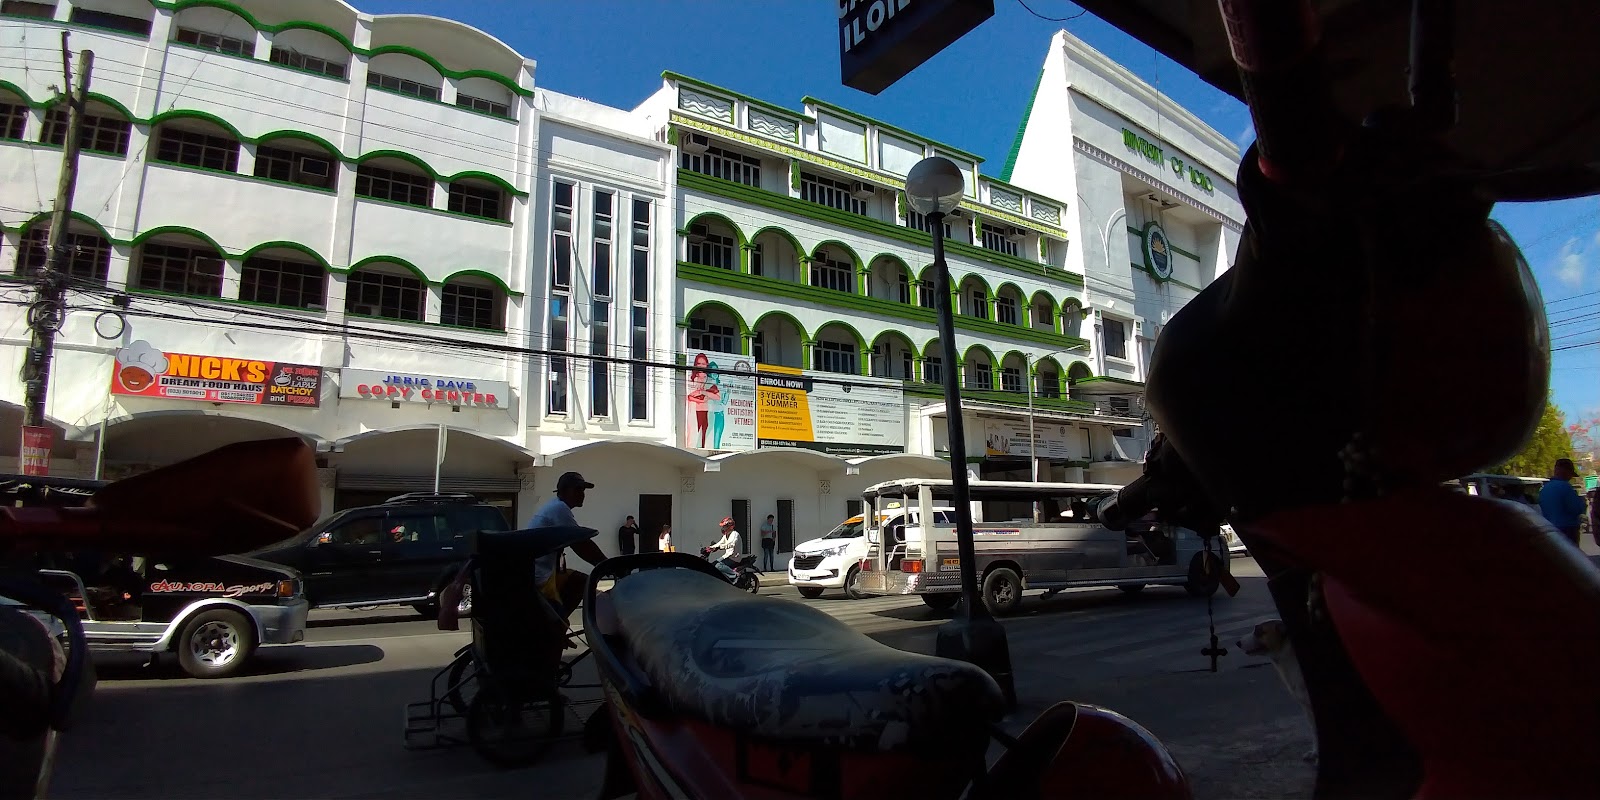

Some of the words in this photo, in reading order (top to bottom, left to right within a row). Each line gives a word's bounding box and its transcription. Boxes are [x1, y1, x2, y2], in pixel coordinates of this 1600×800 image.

[1171, 156, 1184, 177] OF
[168, 354, 266, 383] NICK'S
[161, 377, 200, 388] DREAM
[202, 380, 231, 390] FOOD
[233, 382, 263, 392] HAUS
[384, 375, 430, 387] JERIC
[436, 379, 475, 390] DAVE
[760, 377, 786, 387] ENROLL
[270, 385, 313, 396] BATCHOY
[357, 384, 411, 398] COPY
[421, 389, 496, 404] CENTER
[270, 394, 286, 402] and
[287, 395, 316, 405] PIZZA
[760, 391, 765, 399] 3
[766, 392, 790, 401] YEARS
[791, 394, 797, 402] &
[730, 399, 754, 408] MEDICINE
[766, 400, 798, 409] SUMMER
[727, 407, 754, 417] DENTISTRY
[150, 578, 226, 593] AURORA
